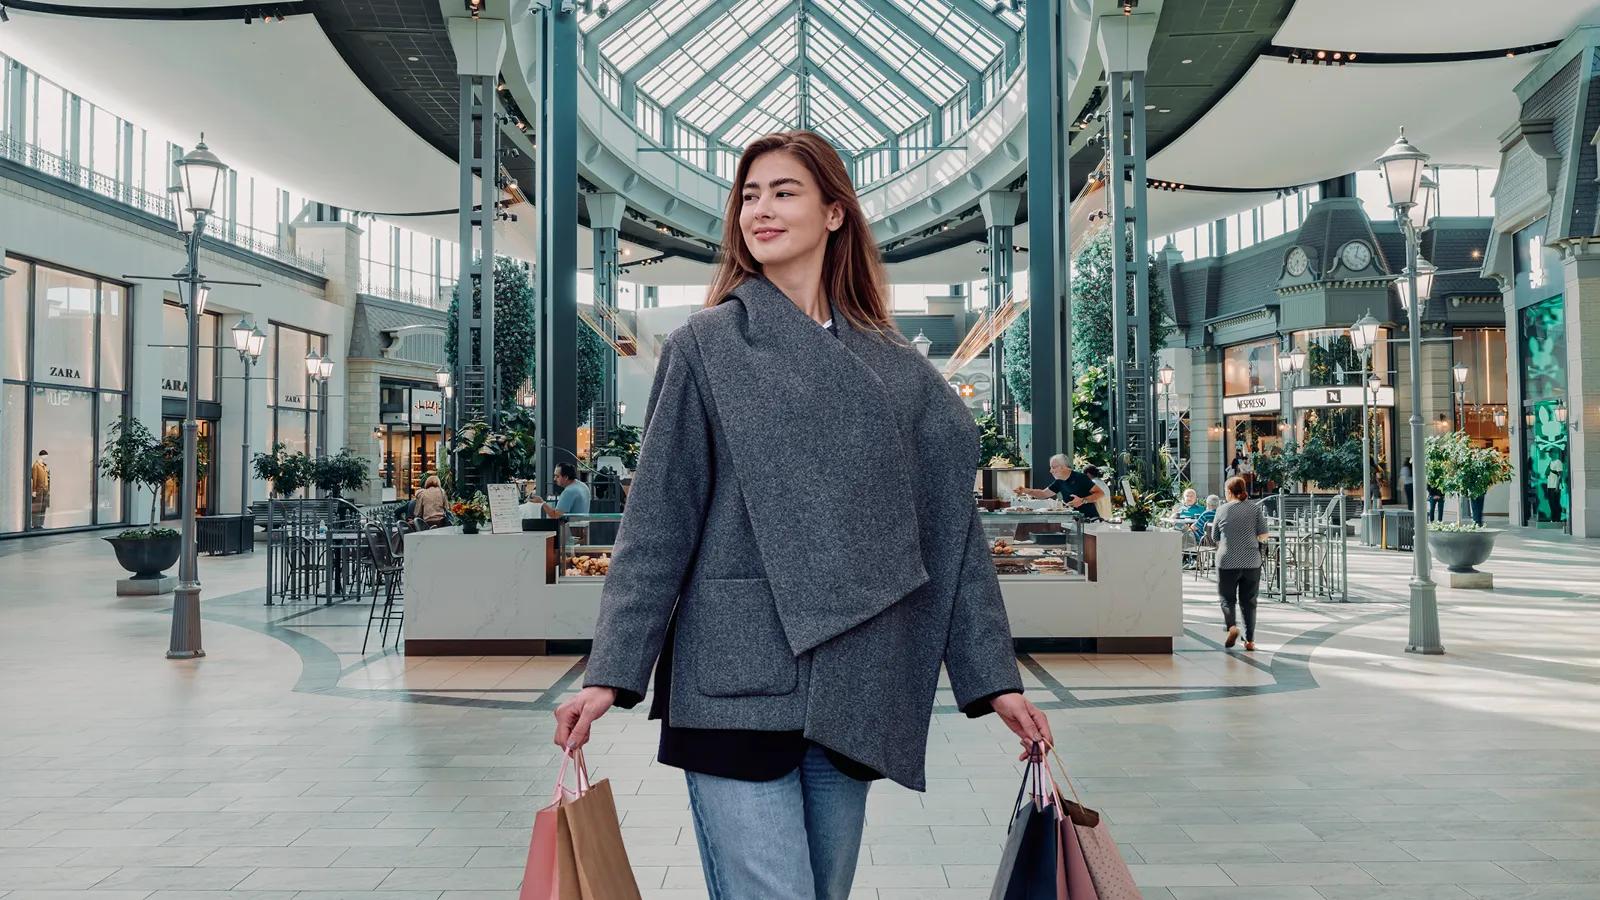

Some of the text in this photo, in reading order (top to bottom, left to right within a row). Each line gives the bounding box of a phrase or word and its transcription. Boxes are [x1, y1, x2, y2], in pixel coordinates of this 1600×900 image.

[50, 366, 80, 379] ZARA
[285, 394, 301, 403] ZARA
[1237, 397, 1267, 411] NESPRESSO
